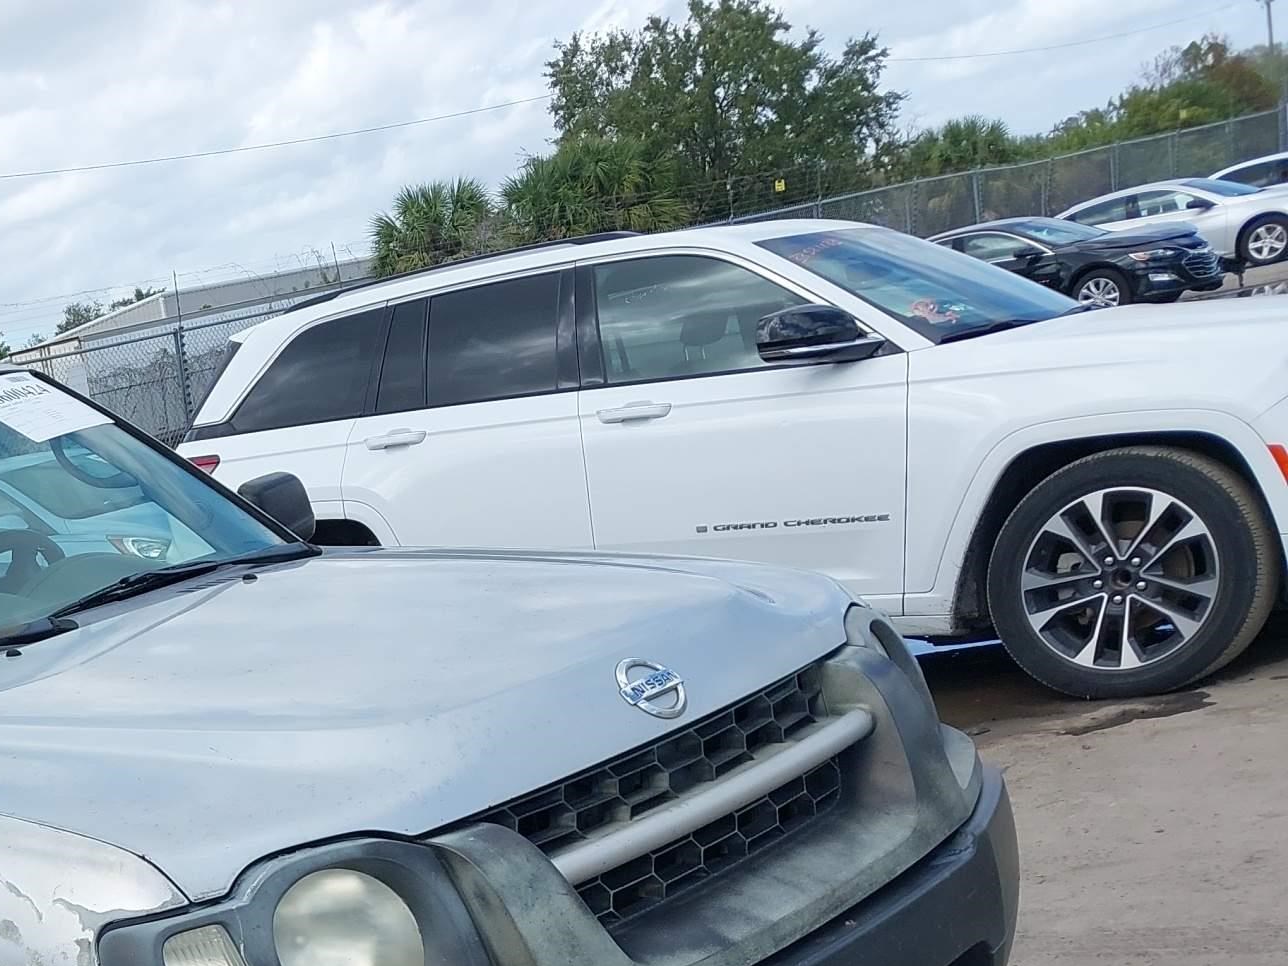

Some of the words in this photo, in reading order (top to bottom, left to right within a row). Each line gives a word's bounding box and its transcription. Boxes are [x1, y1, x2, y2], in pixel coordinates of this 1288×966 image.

[713, 520, 778, 532] GRAND
[783, 513, 891, 529] CHEROKEE
[630, 670, 678, 698] NISSAN
